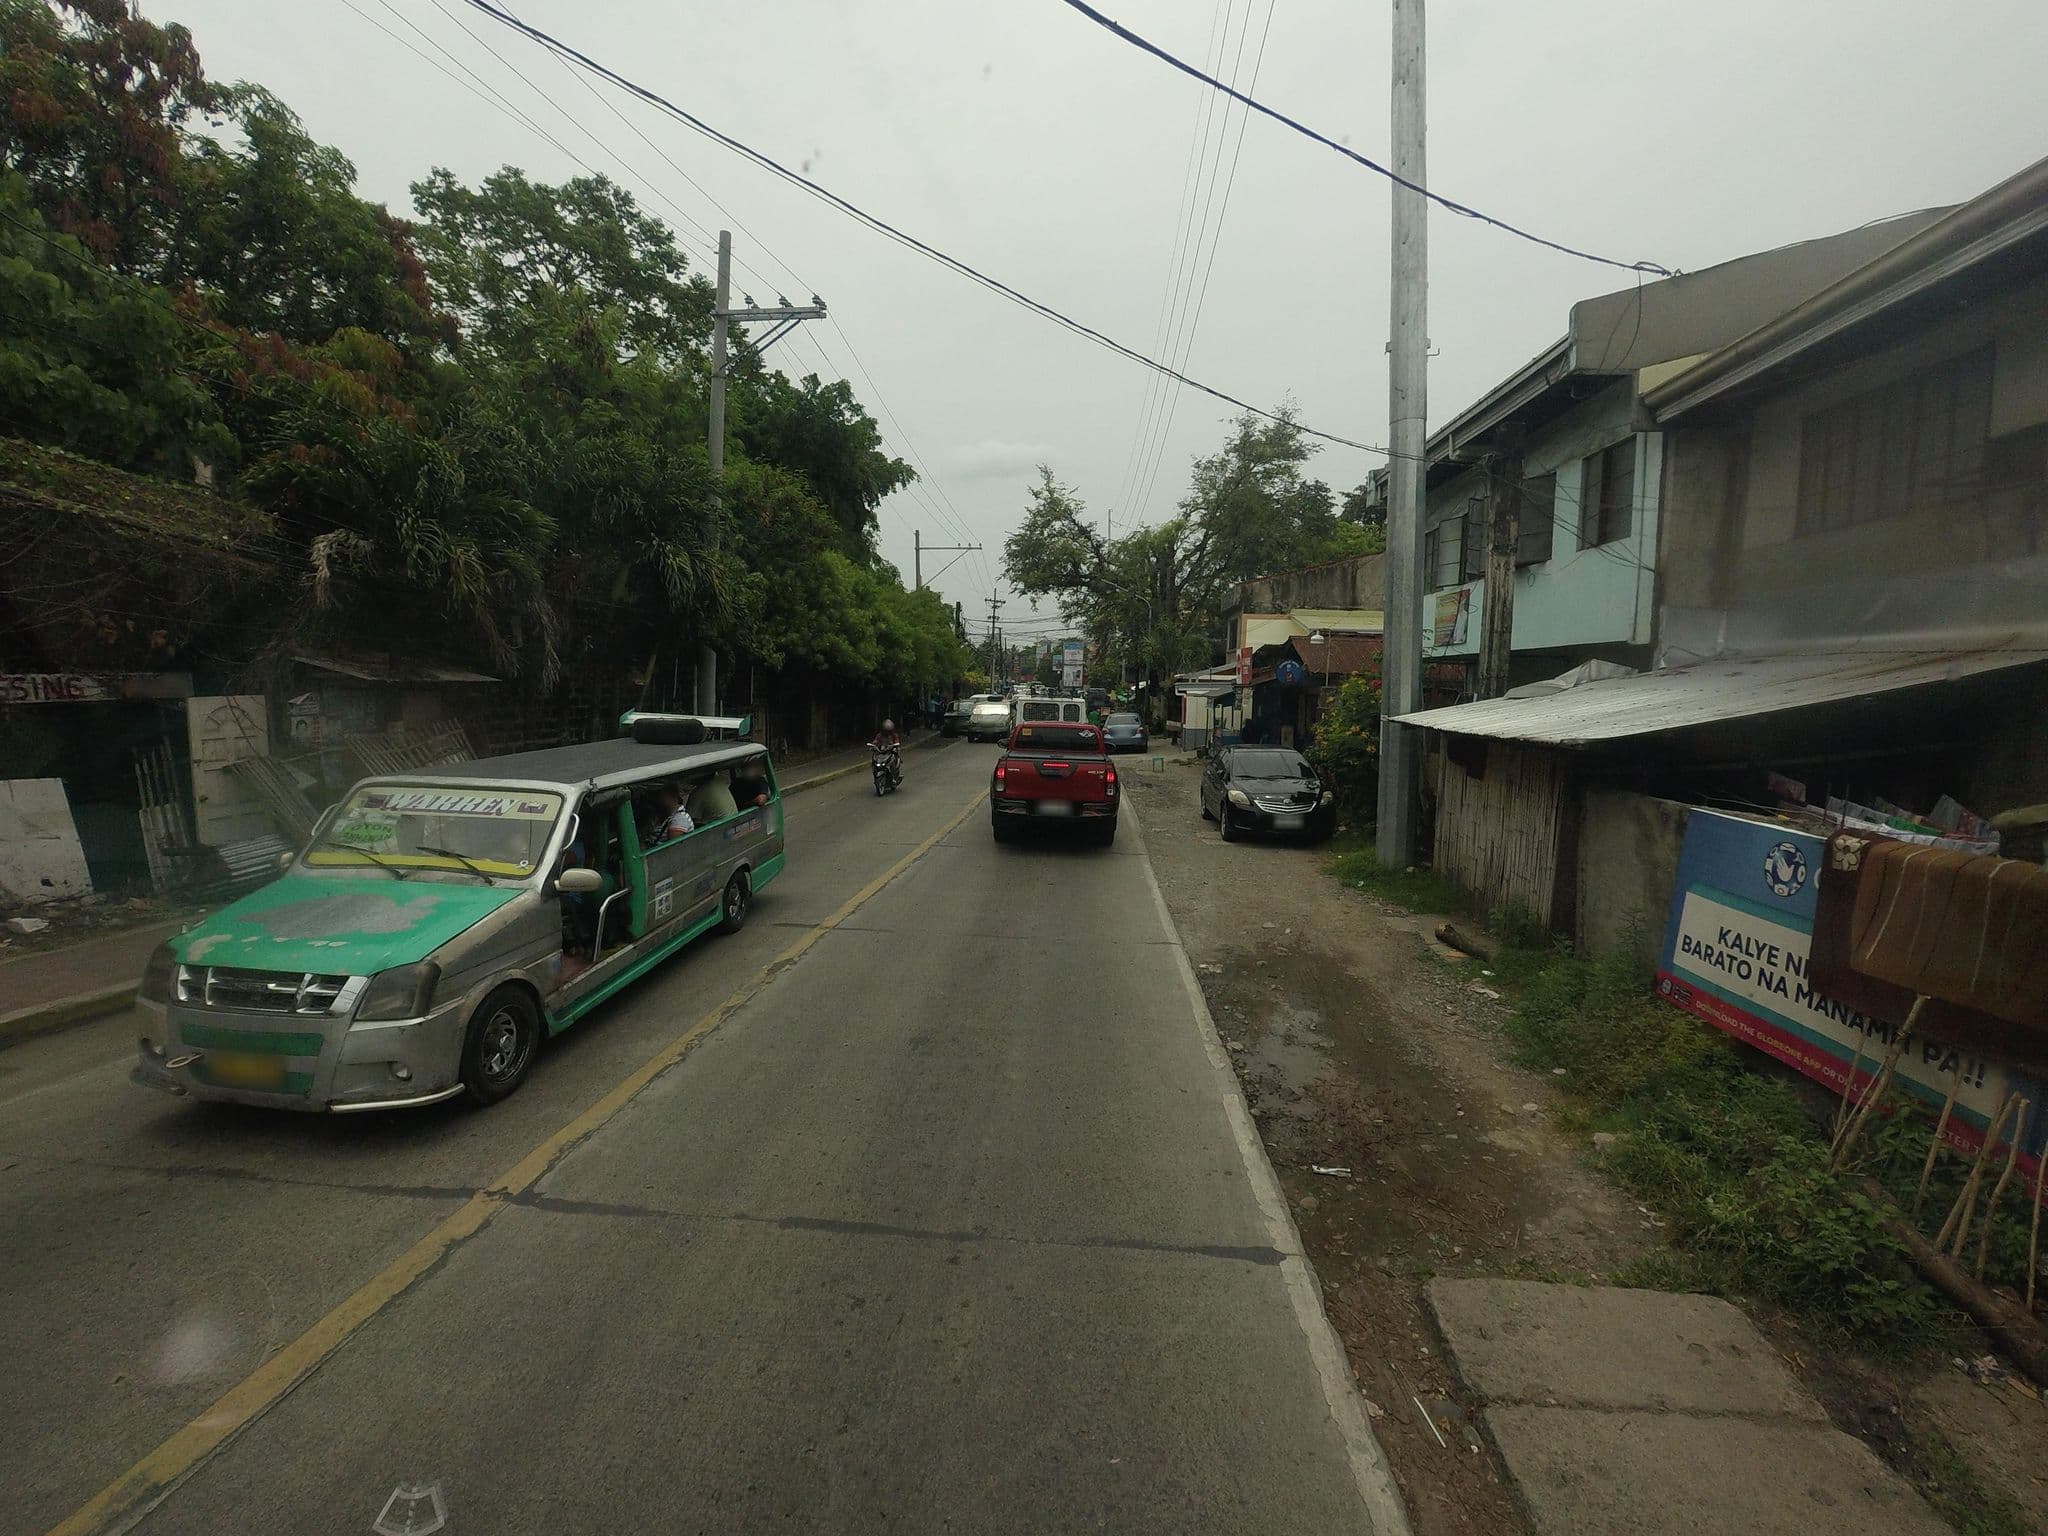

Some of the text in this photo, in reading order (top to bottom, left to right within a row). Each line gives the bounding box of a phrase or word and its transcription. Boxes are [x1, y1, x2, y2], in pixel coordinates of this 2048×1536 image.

[384, 793, 518, 816] WARREN
[1681, 934, 1752, 981] BARATO
[1757, 967, 1790, 1000] NA
[1717, 926, 1780, 968] KALYE
[1695, 1000, 1738, 1028] DOWNLOAD
[1738, 1022, 1755, 1038] THE
[1803, 1056, 1822, 1070] APP
[1823, 1065, 1838, 1081] OR
